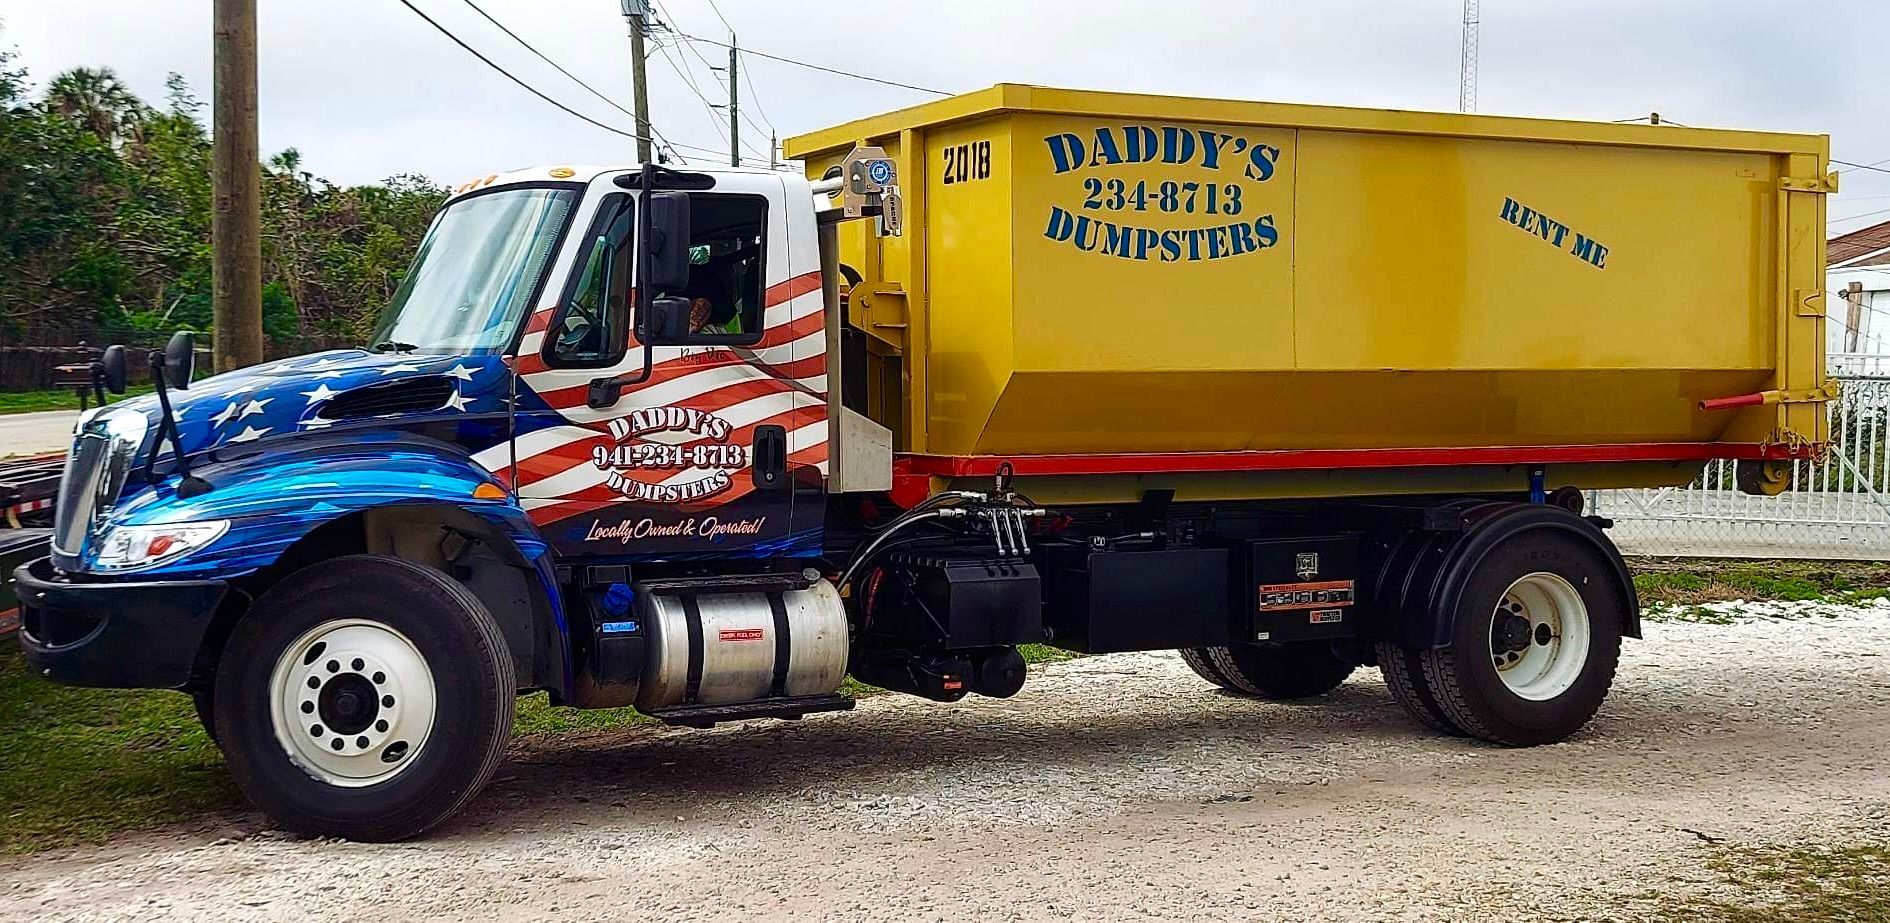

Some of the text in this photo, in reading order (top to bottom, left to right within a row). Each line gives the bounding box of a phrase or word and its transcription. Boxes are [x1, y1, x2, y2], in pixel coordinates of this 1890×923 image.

[943, 140, 991, 185] 2018
[1044, 125, 1280, 182] DADDY'S
[1083, 177, 1243, 215] 234-8713
[1044, 206, 1279, 263] DUMPSTERS
[1500, 196, 1609, 270] RENT ME
[607, 406, 733, 444] DADDY'S
[592, 445, 746, 471] 941-234-8713
[605, 470, 732, 502] DUMPSTERS
[585, 516, 766, 545] Locally Owned & Operated!
